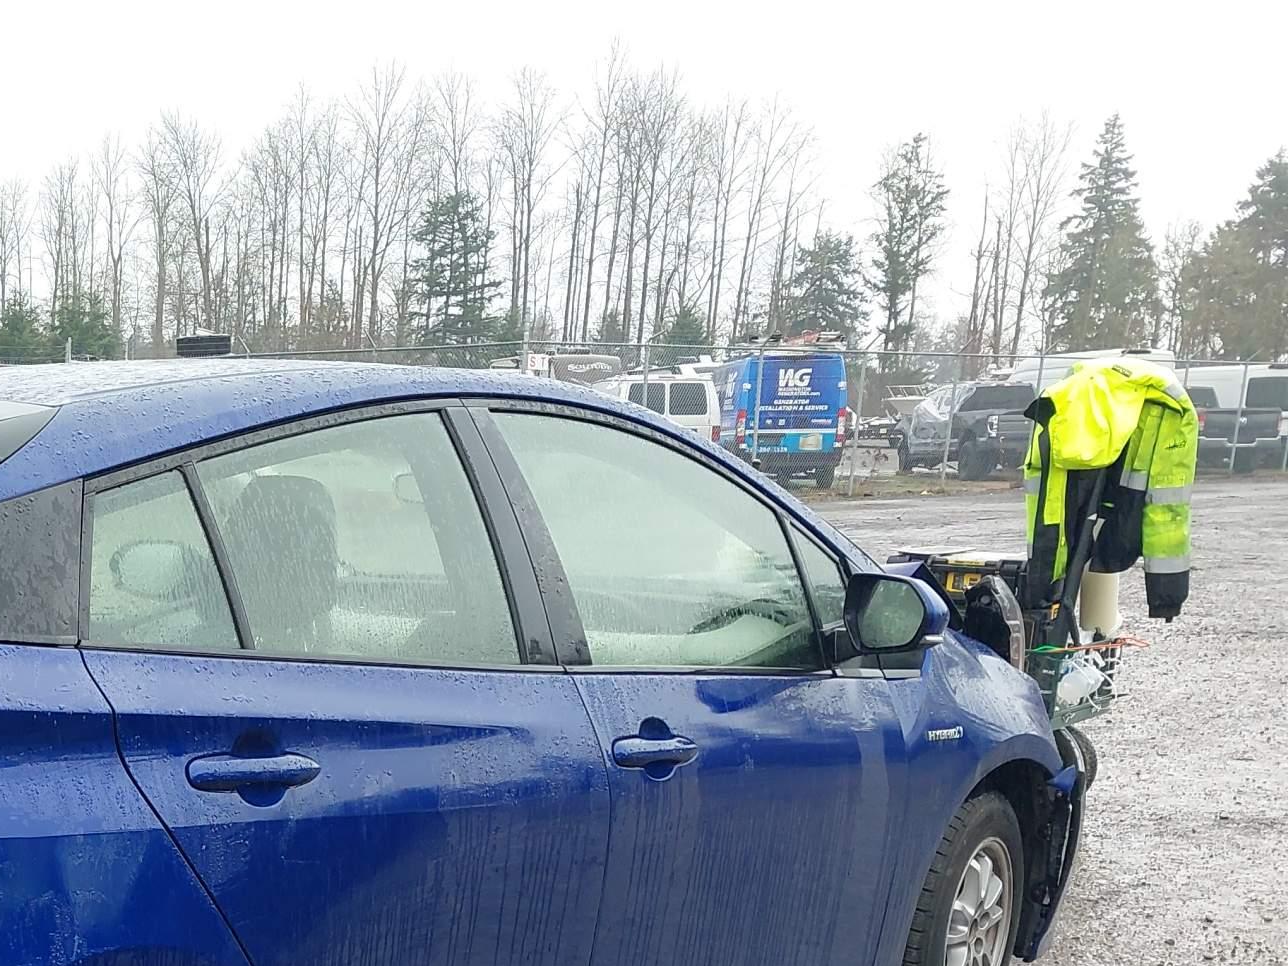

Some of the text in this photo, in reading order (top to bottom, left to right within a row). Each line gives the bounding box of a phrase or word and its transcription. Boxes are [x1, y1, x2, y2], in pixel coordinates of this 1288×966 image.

[530, 355, 536, 367] S
[779, 368, 812, 386] WG
[927, 728, 960, 742] HYBRID
